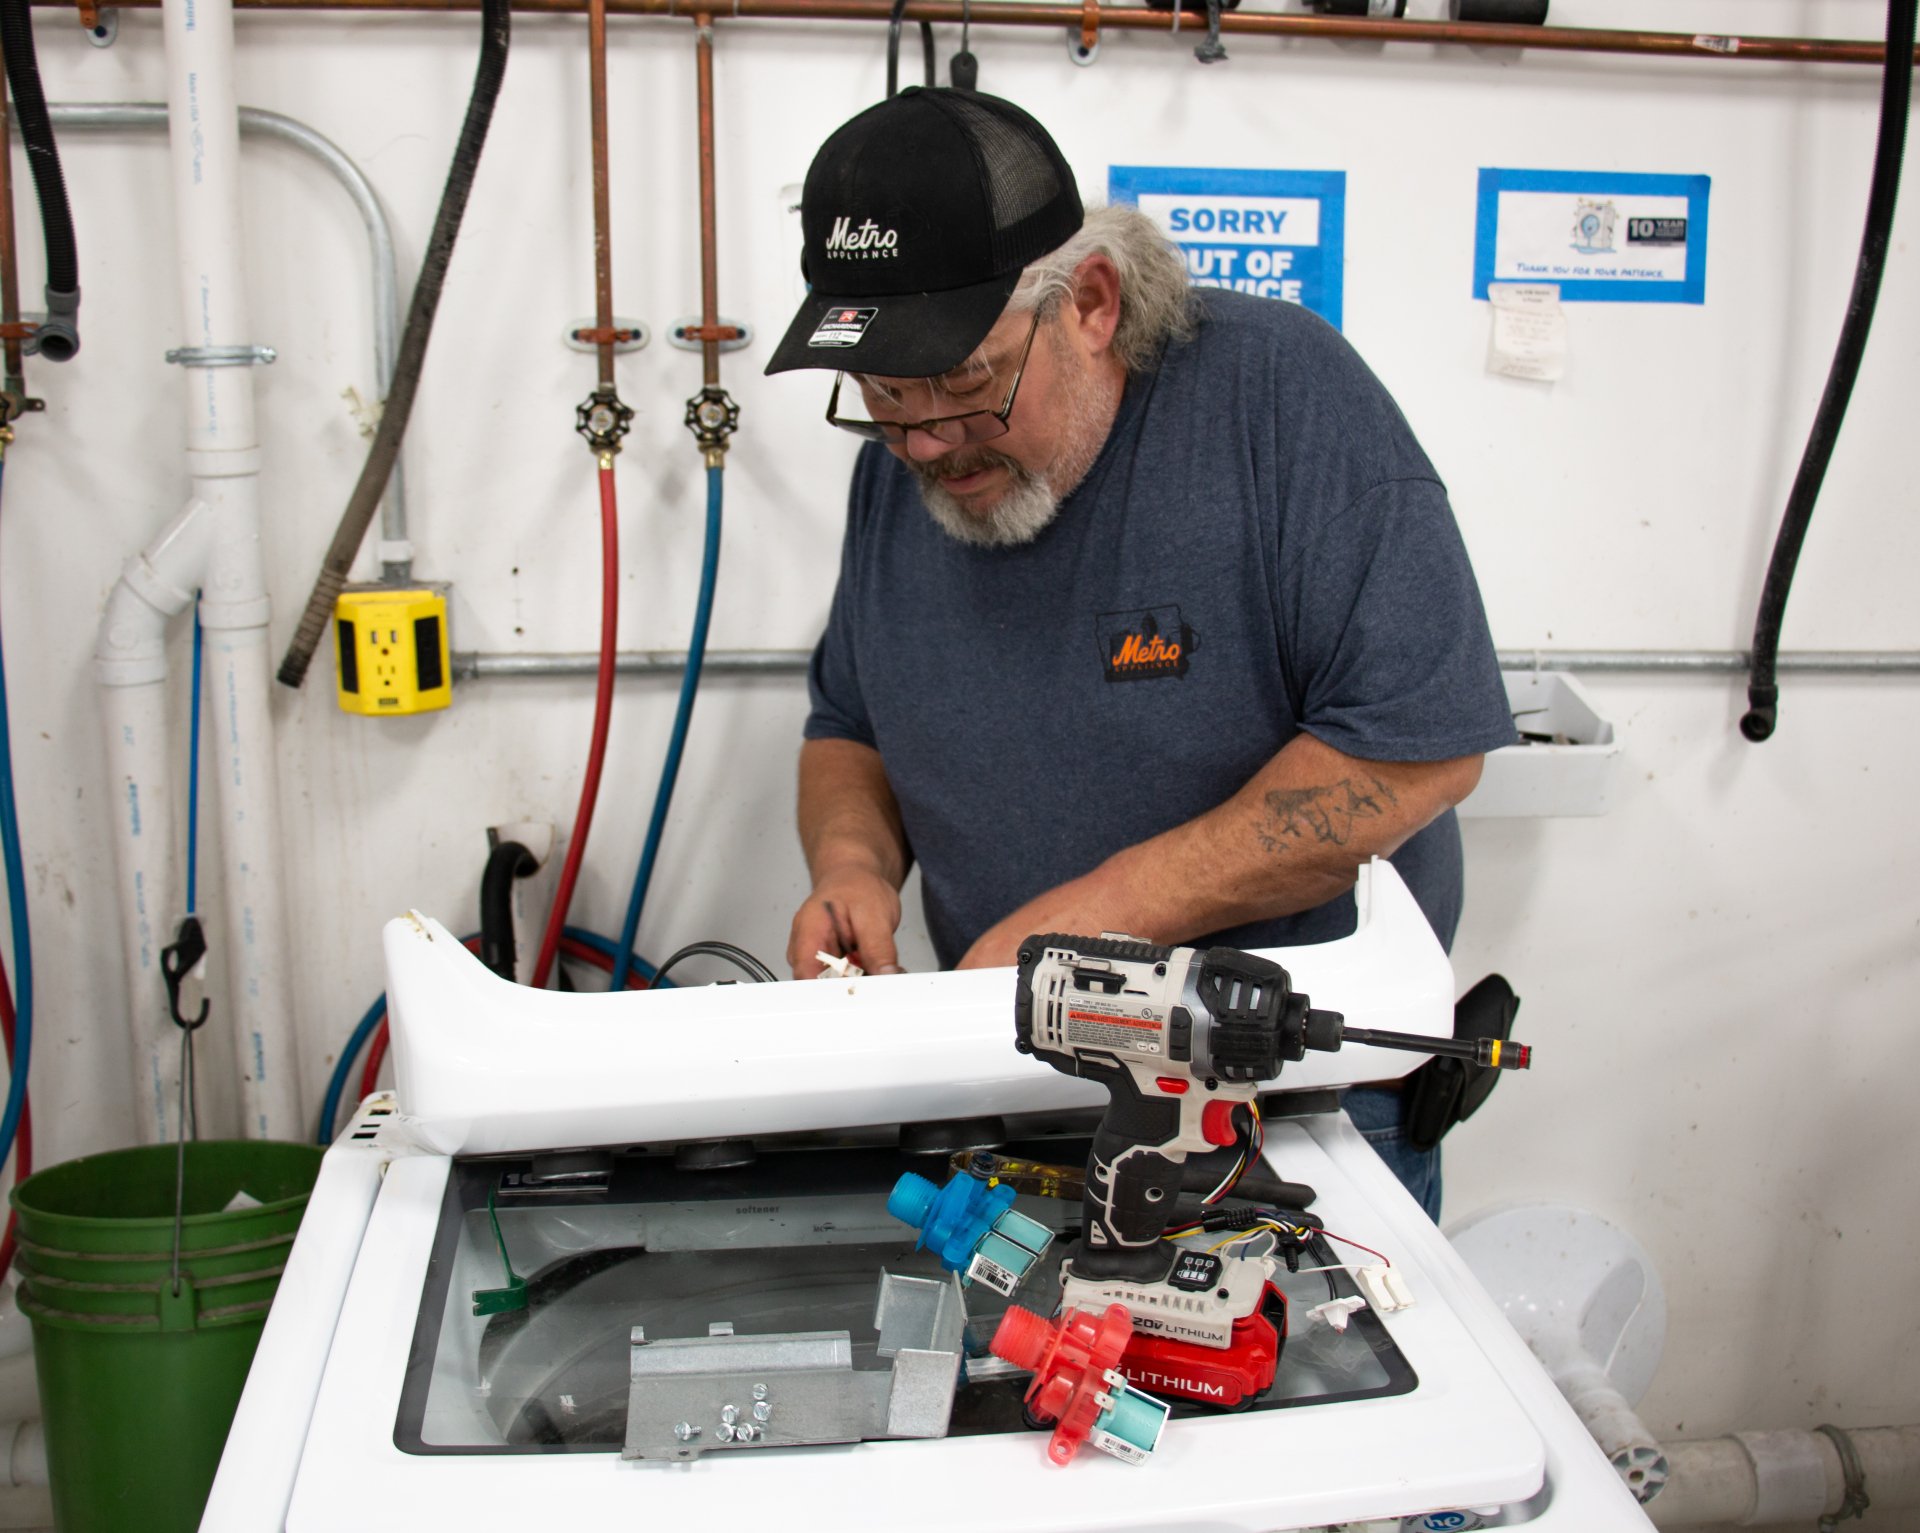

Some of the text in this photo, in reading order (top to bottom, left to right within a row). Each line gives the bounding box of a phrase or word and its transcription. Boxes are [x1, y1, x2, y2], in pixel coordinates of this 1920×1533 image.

[1169, 208, 1288, 234] SORRY
[1630, 219, 1655, 238] 10
[1656, 219, 1685, 227] YEAR
[825, 217, 898, 251] Metro
[1182, 248, 1294, 278] UT OF
[1516, 262, 1549, 273] THANK
[1552, 265, 1569, 274] YOU
[1572, 266, 1590, 275] FOR
[1594, 267, 1617, 276] YOUR
[1112, 634, 1181, 667] Metro
[735, 1204, 780, 1215] softener
[1165, 1324, 1224, 1342] LITHIUM
[1127, 1368, 1224, 1397] LITHIUM
[1424, 1515, 1461, 1528] he
